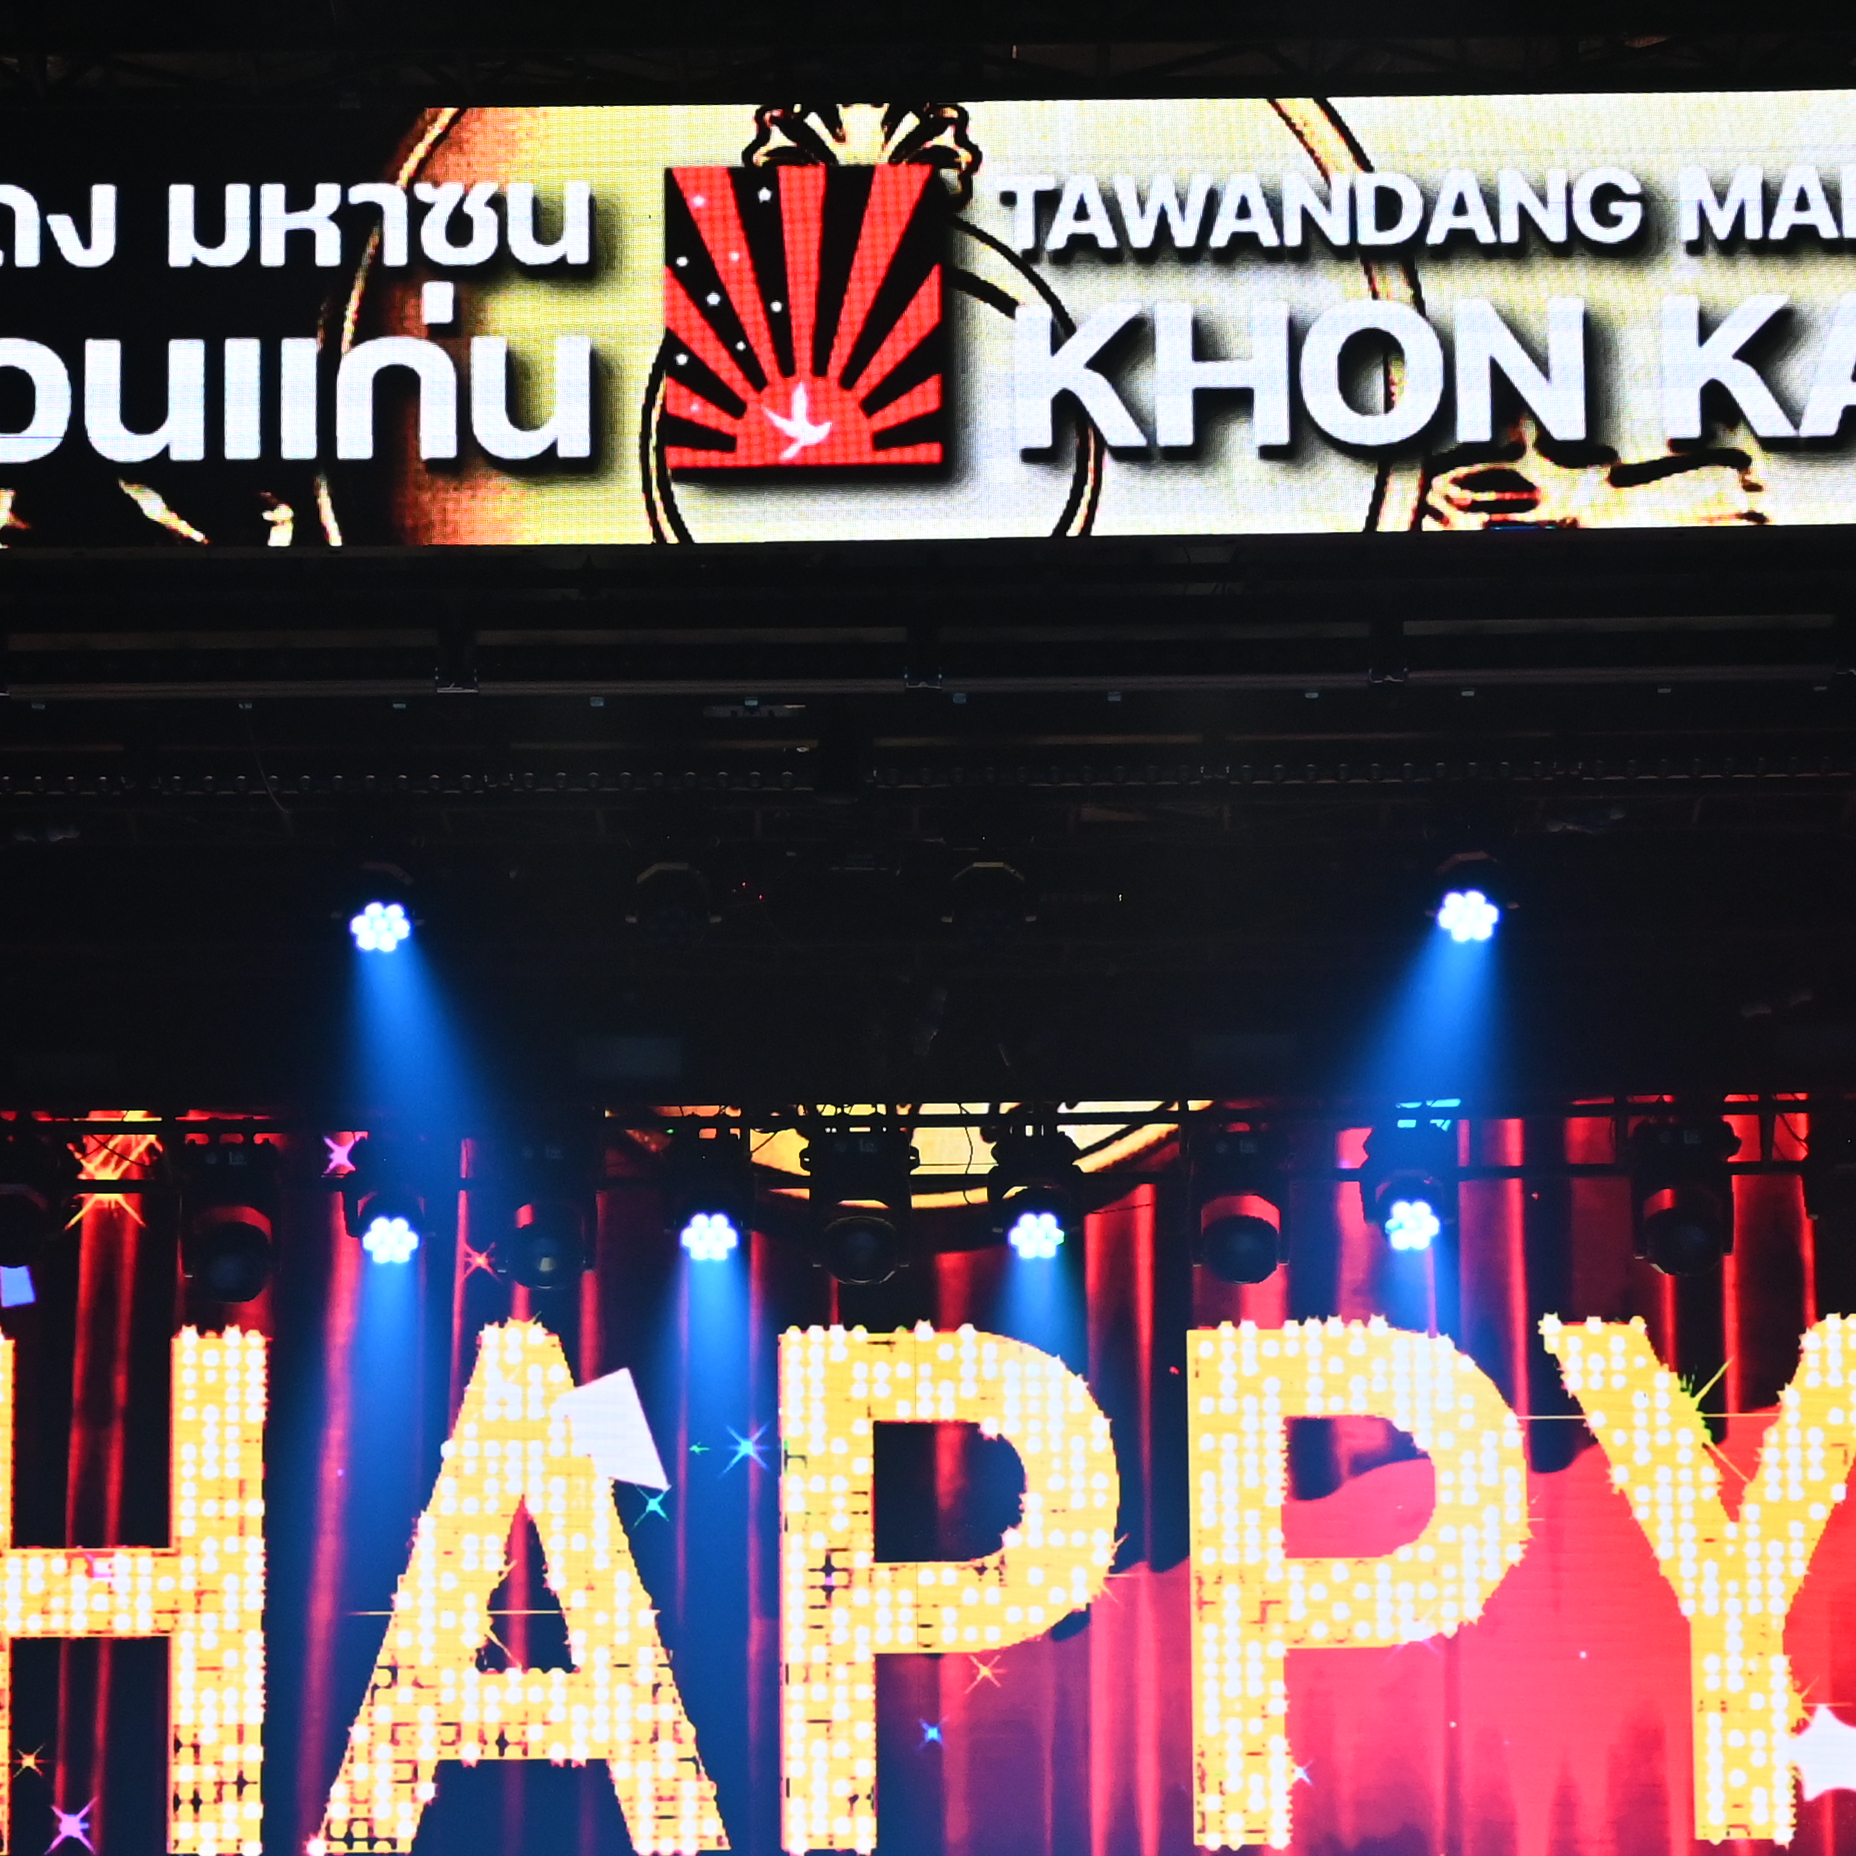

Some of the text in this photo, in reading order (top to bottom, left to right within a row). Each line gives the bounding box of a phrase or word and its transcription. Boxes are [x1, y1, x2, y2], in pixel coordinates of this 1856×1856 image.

[166, 181, 592, 270] มหาชน
[998, 165, 1644, 253] TAWANDANG
[1014, 296, 1587, 456] KHON
